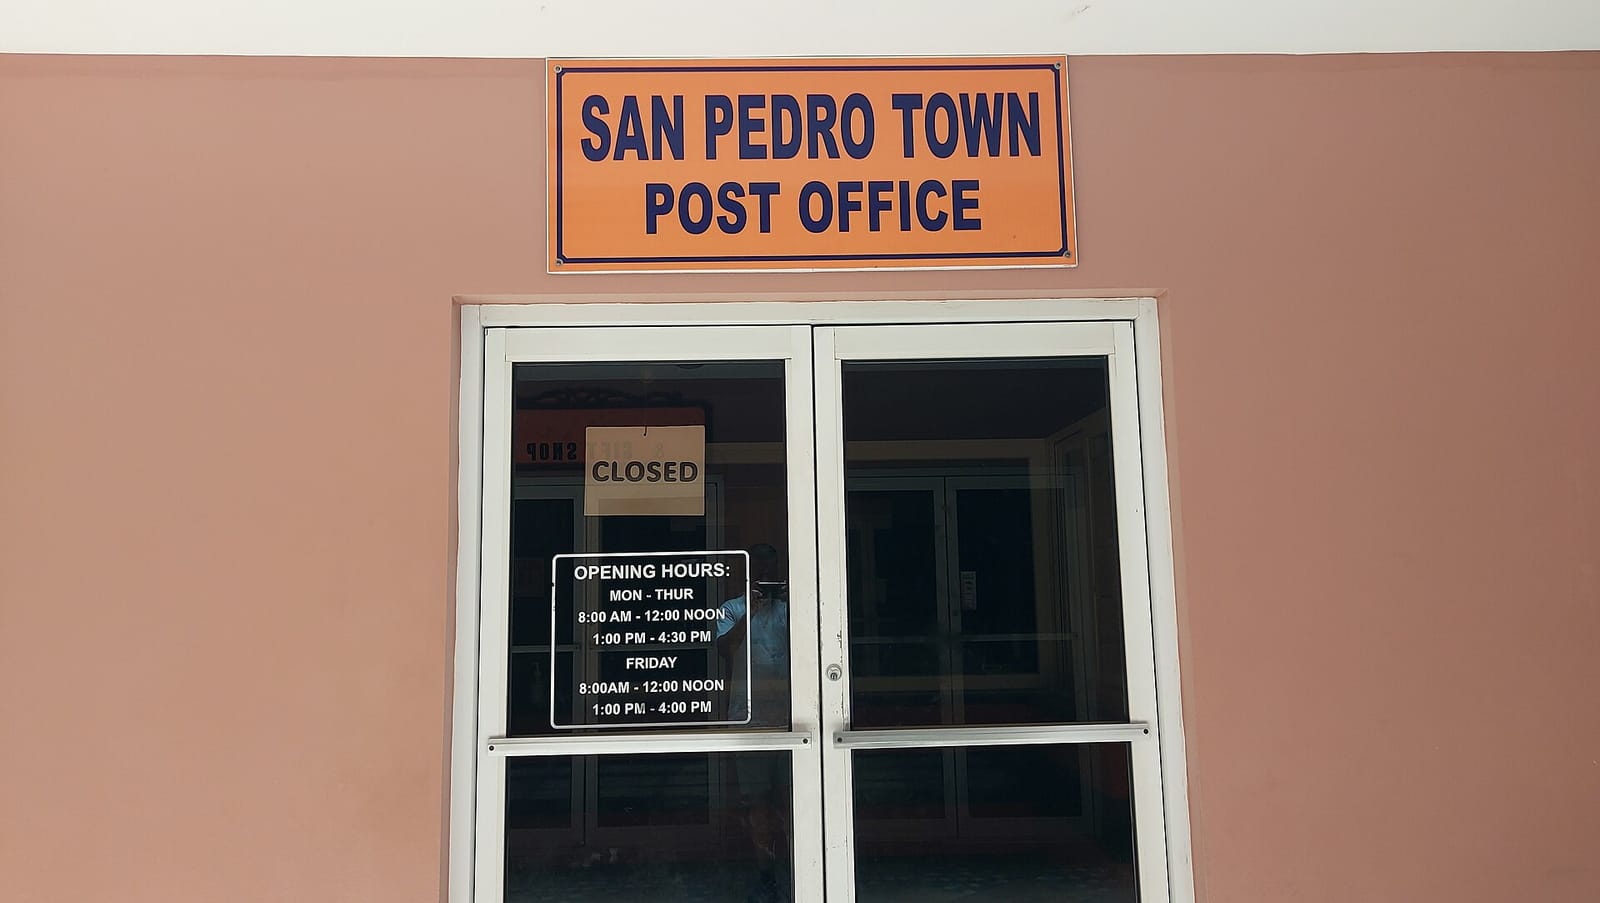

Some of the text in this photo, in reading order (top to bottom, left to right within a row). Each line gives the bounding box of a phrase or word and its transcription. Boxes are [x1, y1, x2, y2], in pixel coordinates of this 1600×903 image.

[580, 92, 1042, 162] SAN PEDRO TOWN
[645, 180, 982, 235] POST OFFICE
[592, 460, 698, 483] CLOSED
[574, 562, 731, 580] OPENING HOURS:
[609, 590, 642, 601] MON
[654, 588, 694, 600] THUR
[578, 611, 607, 623] 8:00
[609, 610, 632, 622] AM
[644, 609, 680, 621] 12:00
[684, 608, 726, 621] NOON
[592, 633, 621, 645] 1:00
[625, 632, 646, 644] PM
[658, 631, 687, 643] 4:30
[690, 630, 711, 642] PM
[626, 656, 678, 669] FRIDAY
[579, 681, 630, 694] 8:00AM
[642, 680, 679, 692] 12:00
[682, 679, 725, 692] NOON
[592, 703, 621, 715] 1:00
[624, 702, 646, 714] PM
[658, 701, 687, 714] 4:00
[691, 700, 712, 713] PM
